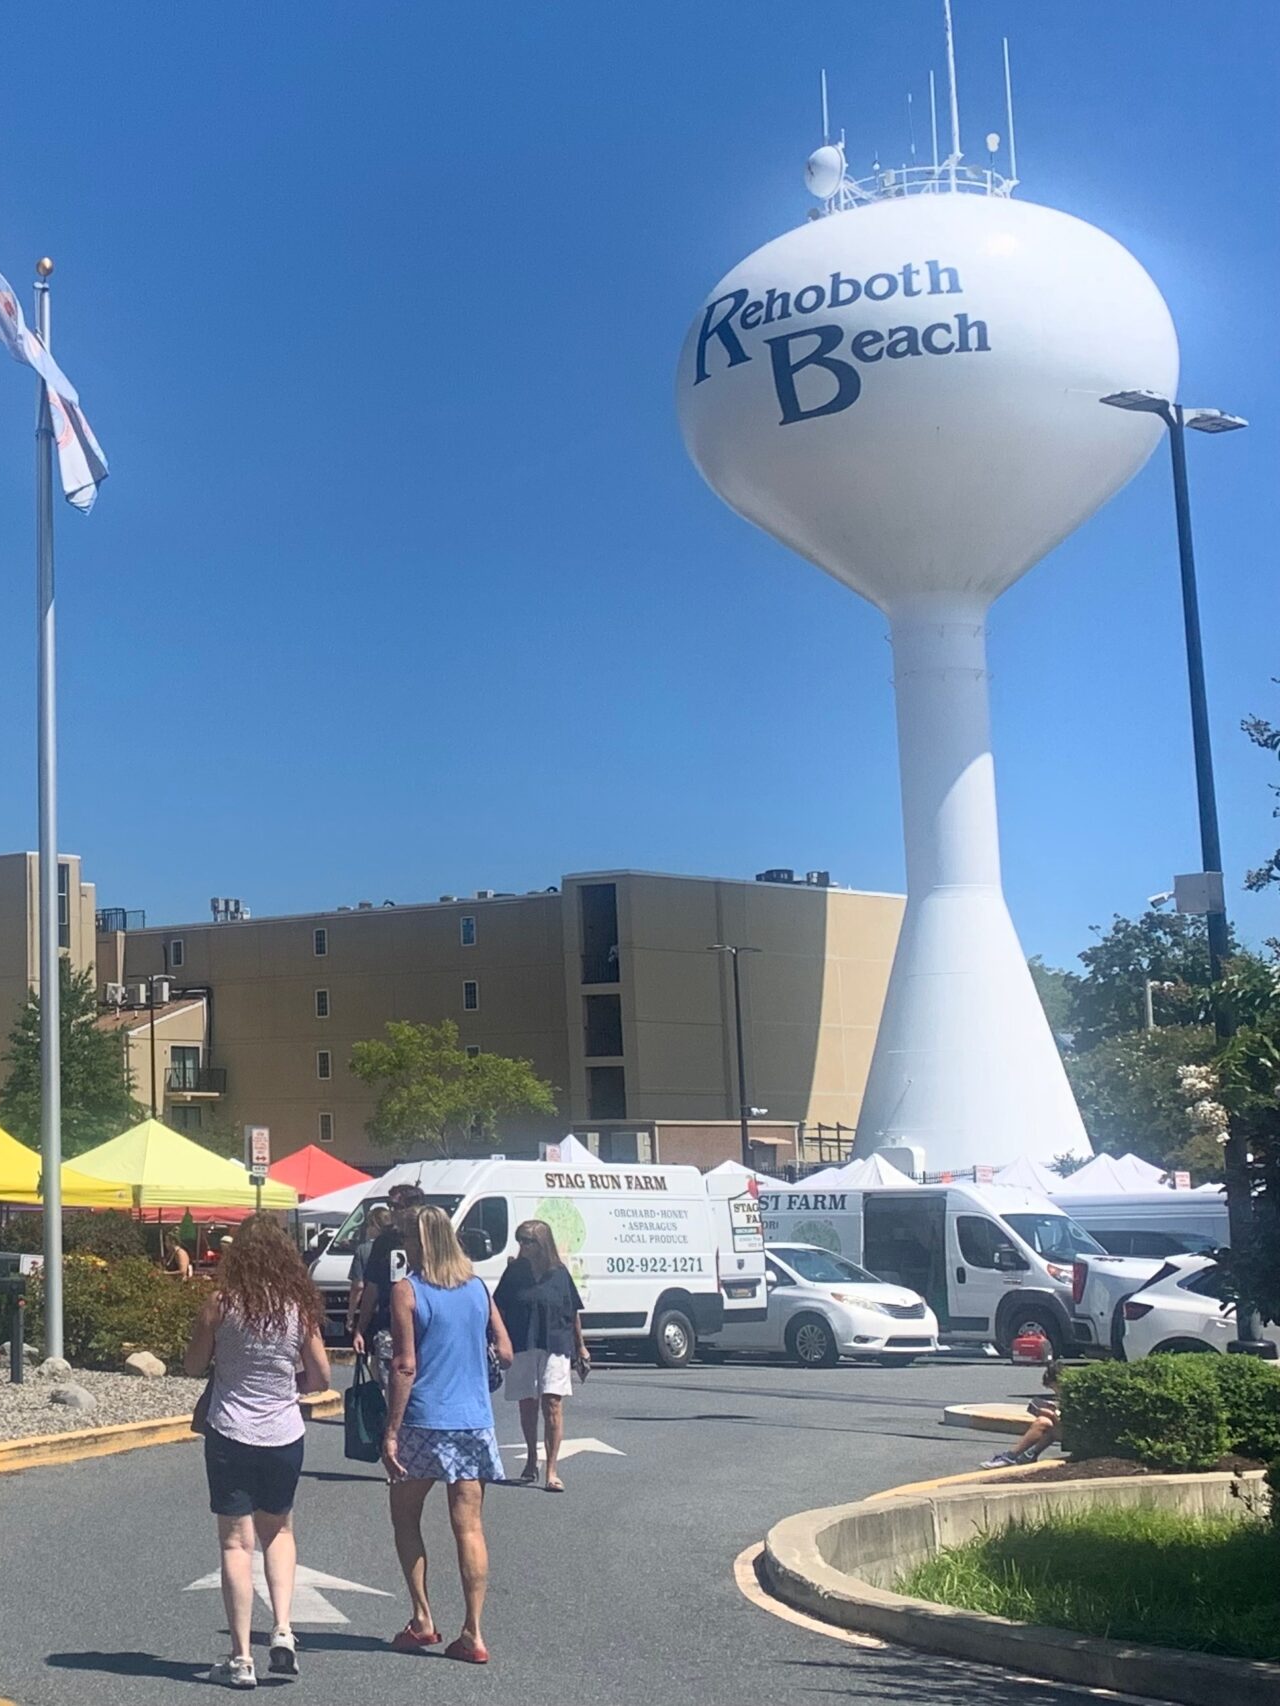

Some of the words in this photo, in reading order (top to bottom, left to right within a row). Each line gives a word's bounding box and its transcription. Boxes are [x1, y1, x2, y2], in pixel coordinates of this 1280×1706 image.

[693, 260, 963, 386] Rehoboth
[764, 313, 991, 426] Beach
[545, 1173, 585, 1189] STAG
[589, 1174, 622, 1190] RUN
[626, 1175, 668, 1191] FARM
[786, 1194, 848, 1211] FARM
[614, 1209, 656, 1219] ORCHARD
[660, 1210, 689, 1219] HONEY
[627, 1222, 677, 1232] ASPARAGUS
[619, 1234, 647, 1244] LOCAL
[649, 1236, 688, 1245] PRODUCE
[607, 1257, 703, 1273] 302-922-1271
